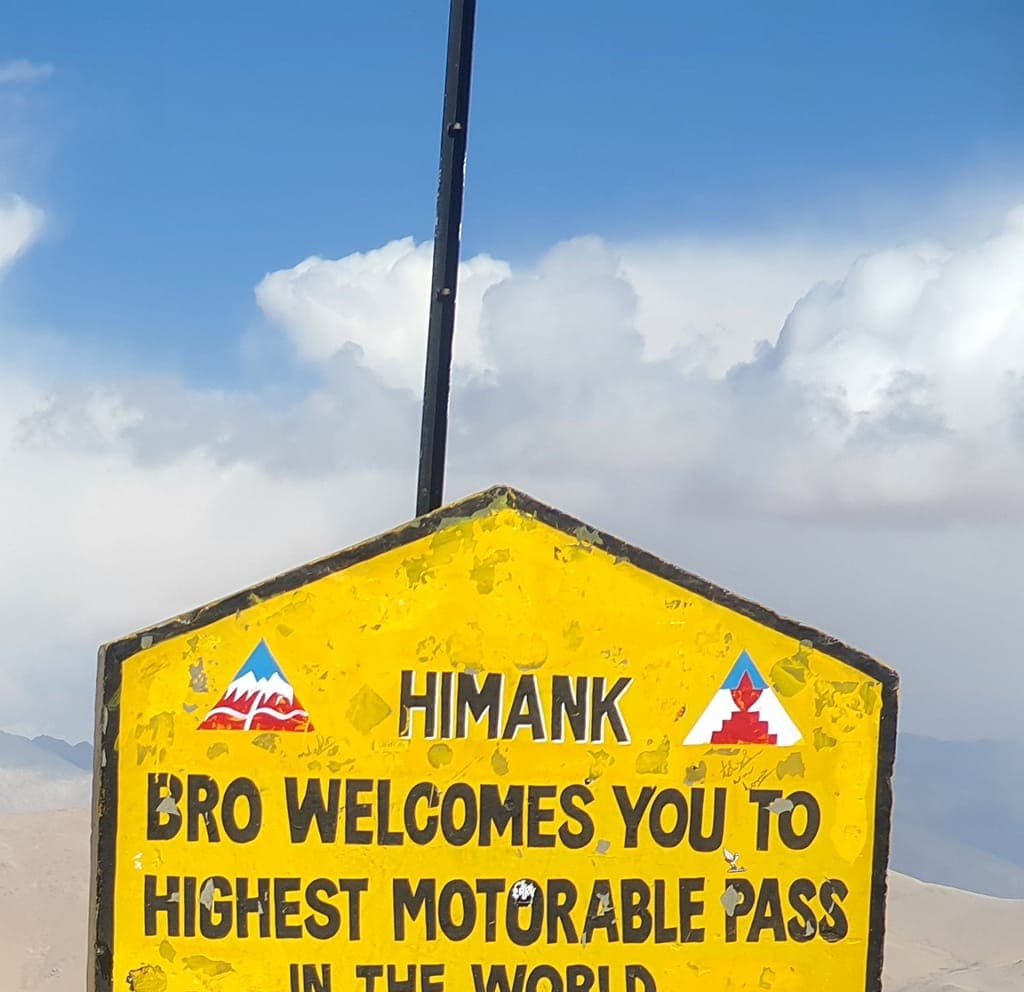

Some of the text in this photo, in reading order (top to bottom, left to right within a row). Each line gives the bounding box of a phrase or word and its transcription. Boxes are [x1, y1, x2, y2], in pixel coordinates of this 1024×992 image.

[398, 670, 631, 744] HIMANK
[147, 773, 820, 851] BRO WELCOMES YOU TO
[144, 874, 849, 945] HIGHEST MOTORABLE PASS
